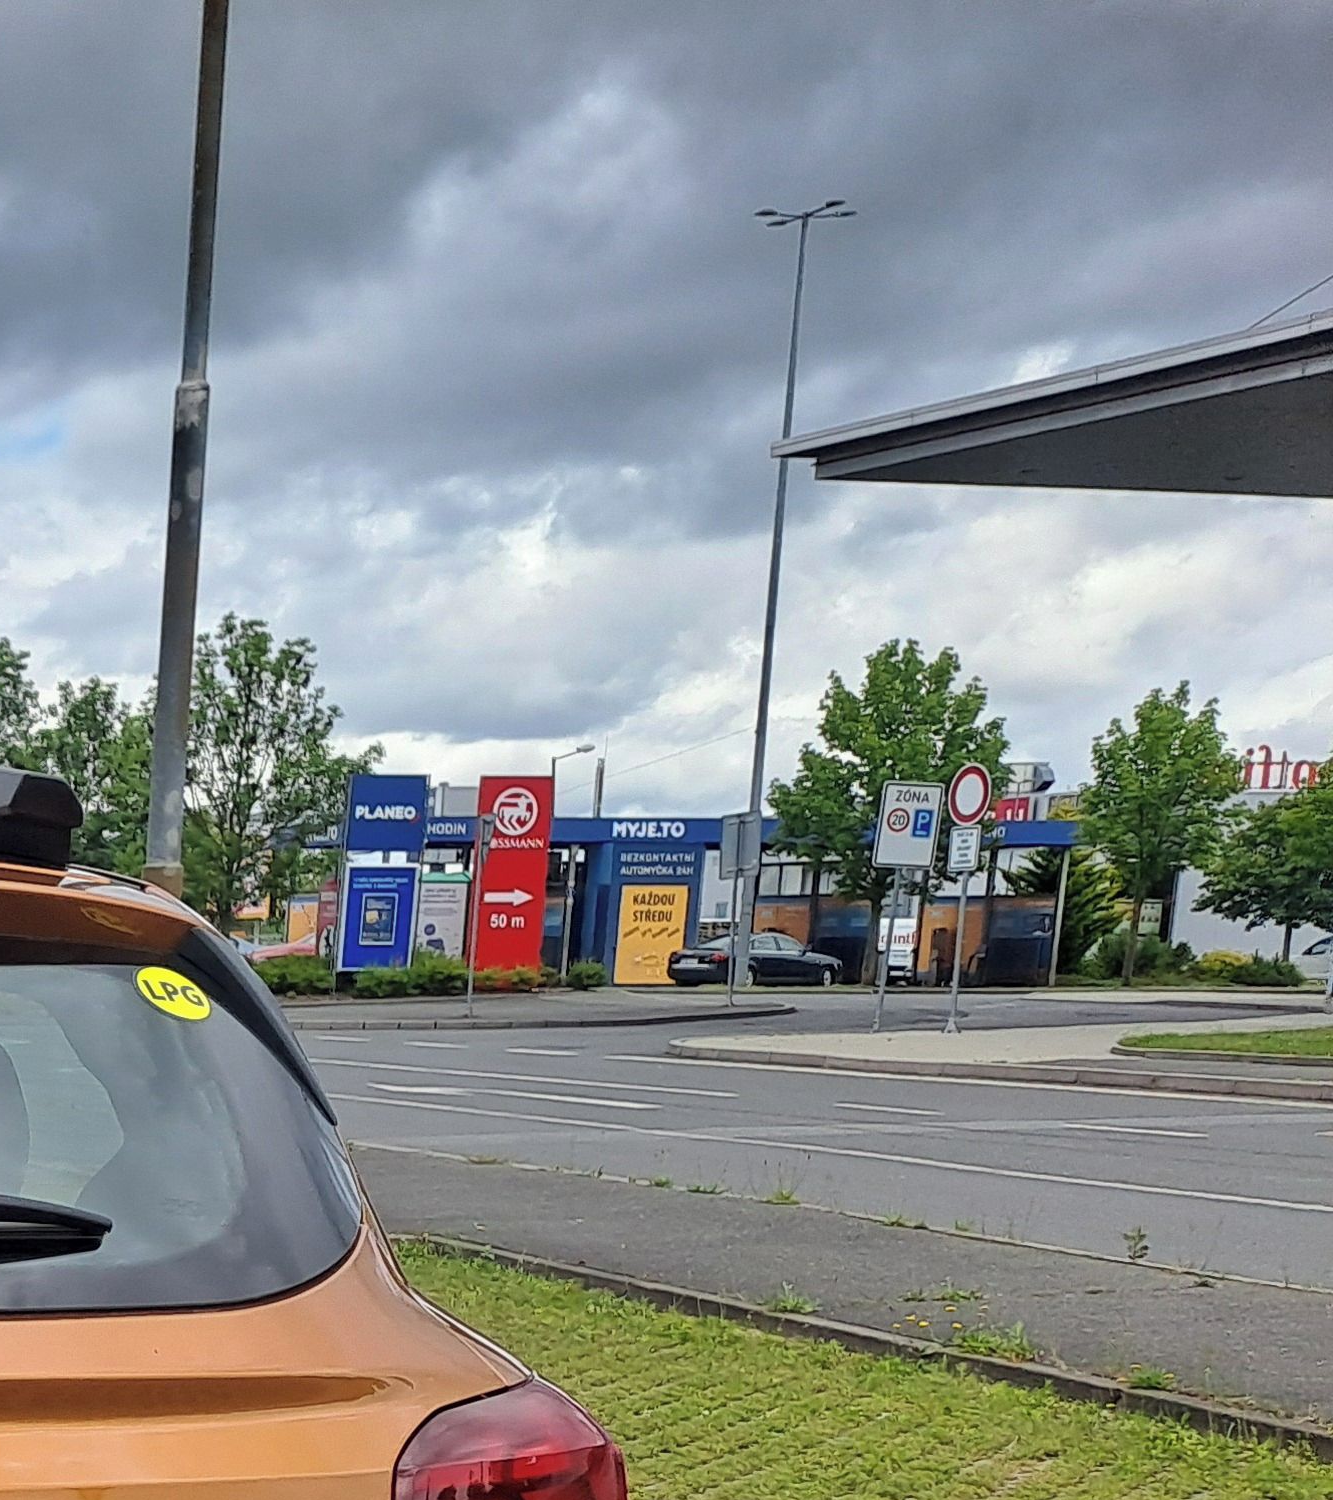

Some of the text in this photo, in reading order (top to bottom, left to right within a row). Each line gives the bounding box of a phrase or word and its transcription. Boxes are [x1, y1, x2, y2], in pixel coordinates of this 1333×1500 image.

[895, 789, 931, 804] ZÓNA
[354, 804, 416, 820] PLANEO
[891, 814, 905, 826] 20
[916, 811, 931, 829] P
[427, 822, 467, 835] HODIN
[611, 821, 686, 839] MYJE.TO
[488, 836, 544, 849] OSSMANN
[620, 851, 695, 863] BEZKONTAKTNÍ
[632, 890, 676, 907] KAŽDOU
[489, 913, 526, 929] 50 m
[632, 908, 673, 923] STŘEDU
[141, 979, 205, 1007] LPG
